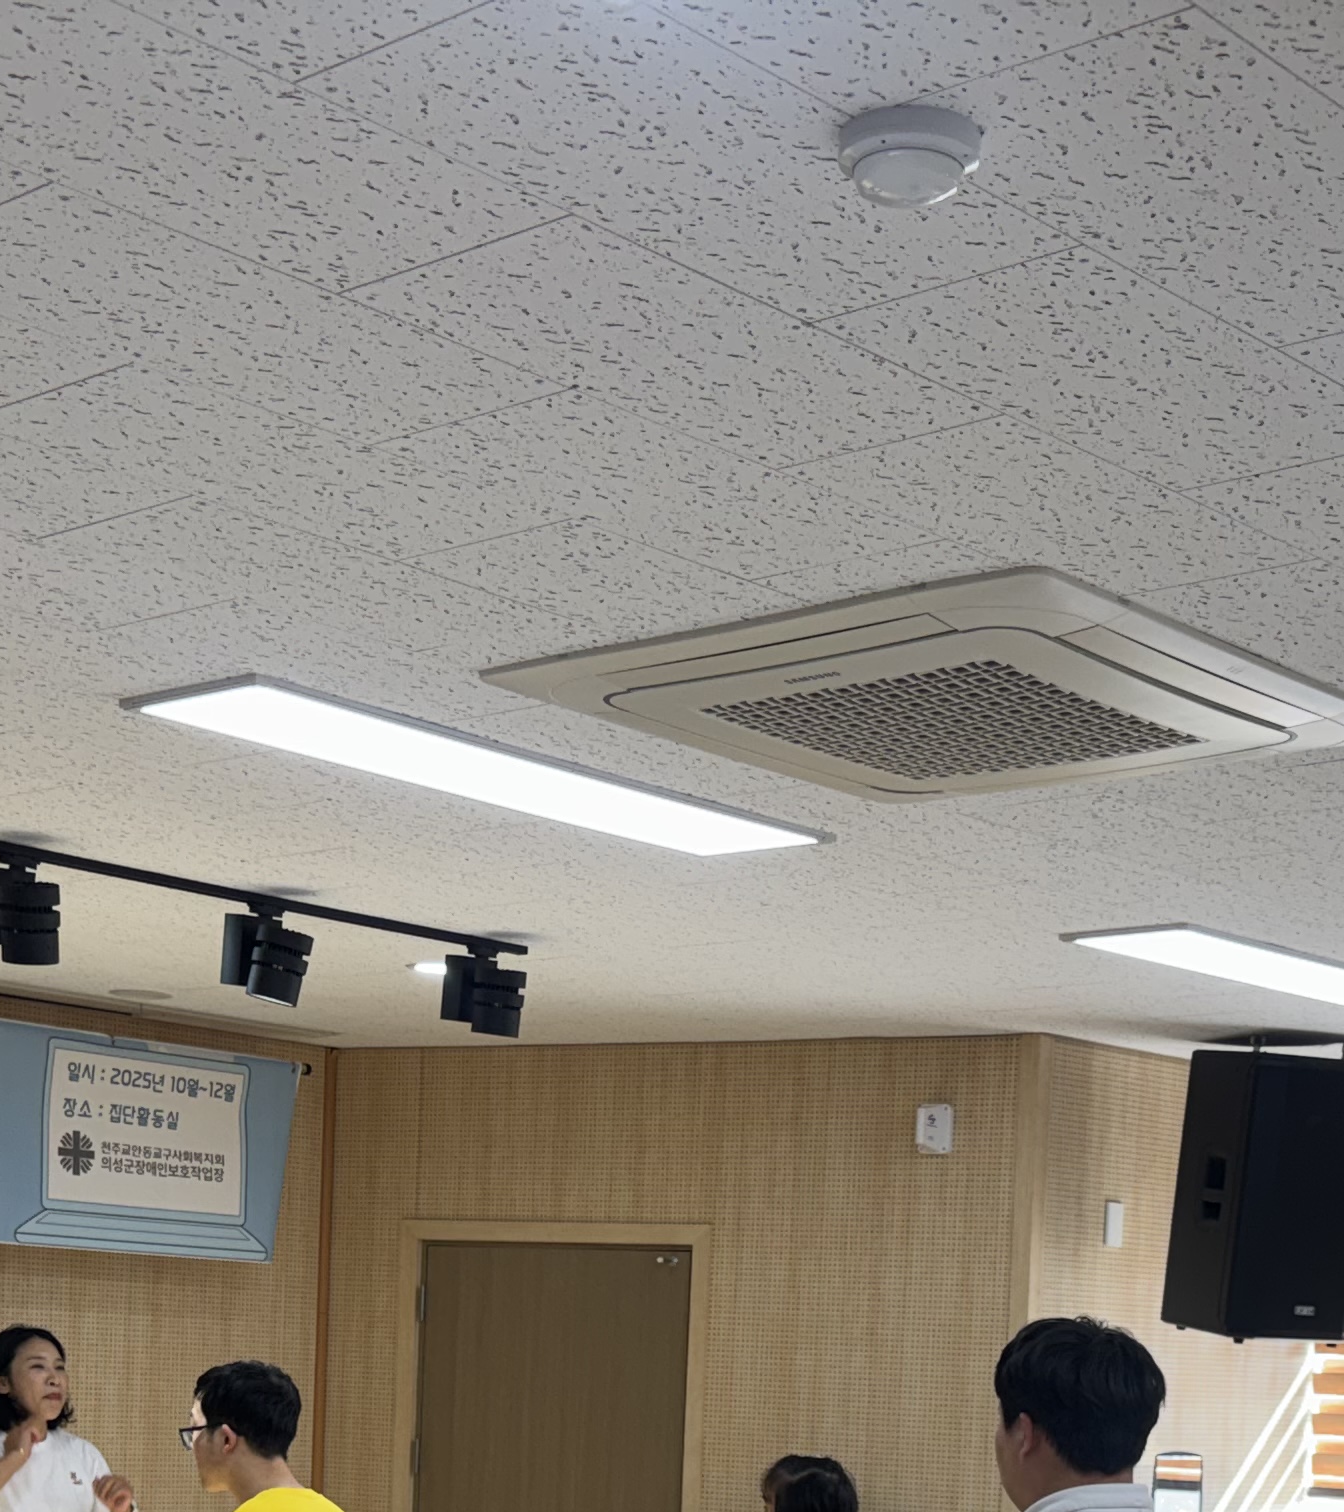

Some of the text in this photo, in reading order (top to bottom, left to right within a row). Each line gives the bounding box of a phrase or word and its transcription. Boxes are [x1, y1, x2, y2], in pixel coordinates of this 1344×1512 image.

[67, 1062, 95, 1084] 일시
[110, 1067, 165, 1093] 2025년
[171, 1075, 236, 1103] 10월~12월
[63, 1097, 92, 1118] 장소
[109, 1103, 179, 1131] 집단활동실
